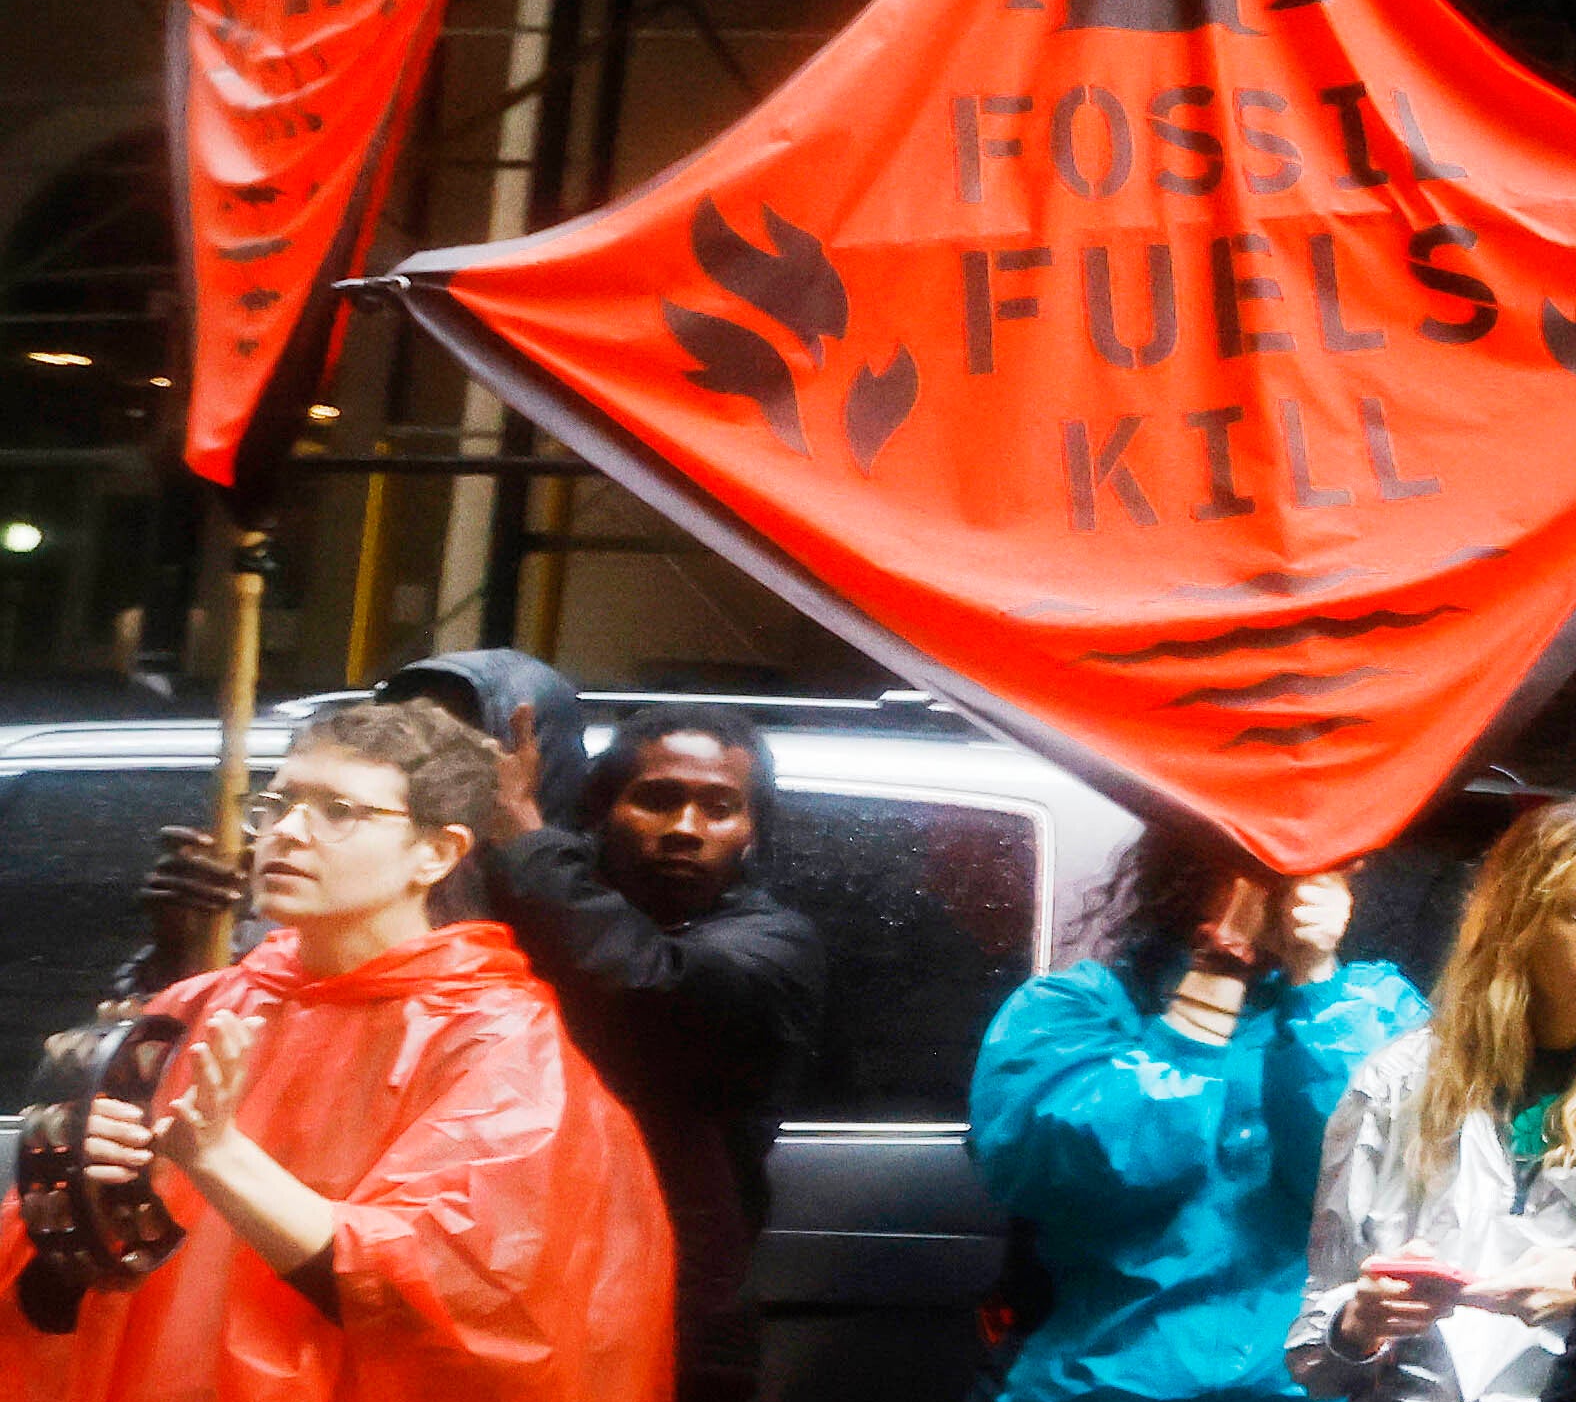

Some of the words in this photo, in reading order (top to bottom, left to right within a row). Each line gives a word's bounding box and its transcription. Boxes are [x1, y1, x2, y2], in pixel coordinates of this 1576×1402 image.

[950, 81, 1468, 205] FOSSIL
[961, 223, 1500, 376] FUELS
[1060, 397, 1443, 532] KILL
